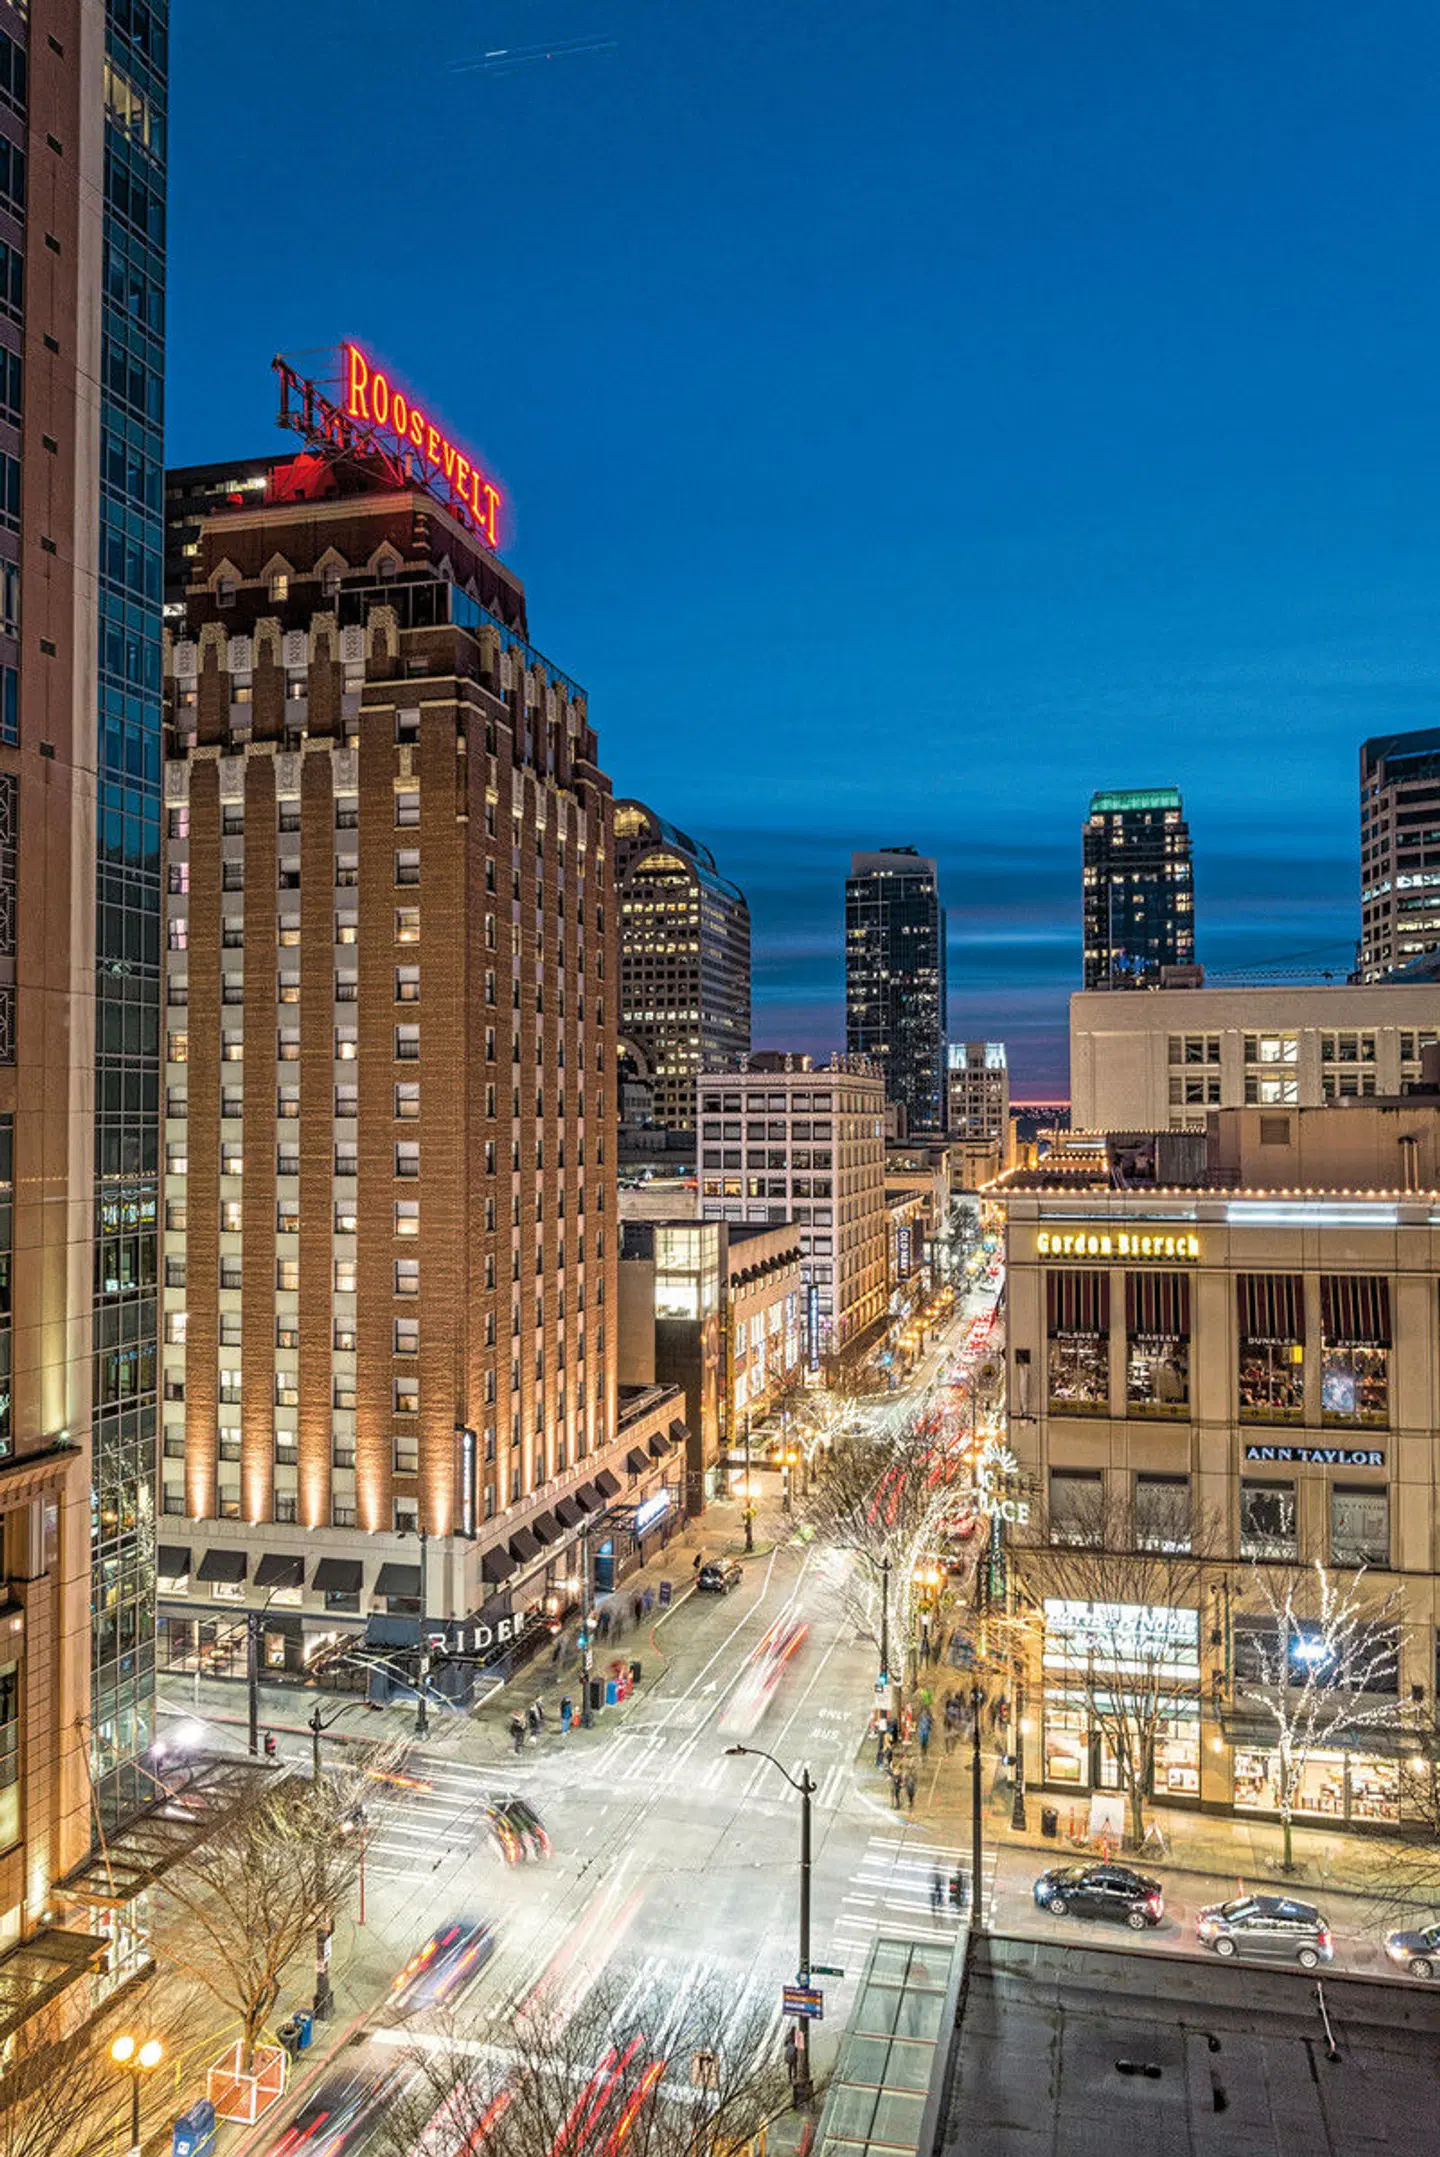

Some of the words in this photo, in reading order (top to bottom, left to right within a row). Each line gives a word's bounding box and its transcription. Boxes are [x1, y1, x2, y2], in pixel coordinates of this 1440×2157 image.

[348, 344, 500, 547] ROOSEVELT
[1037, 1232, 1112, 1254] Gordon
[1118, 1233, 1199, 1256] Biersch
[1247, 1446, 1292, 1460] ANN
[1298, 1449, 1382, 1465] TAYLOR
